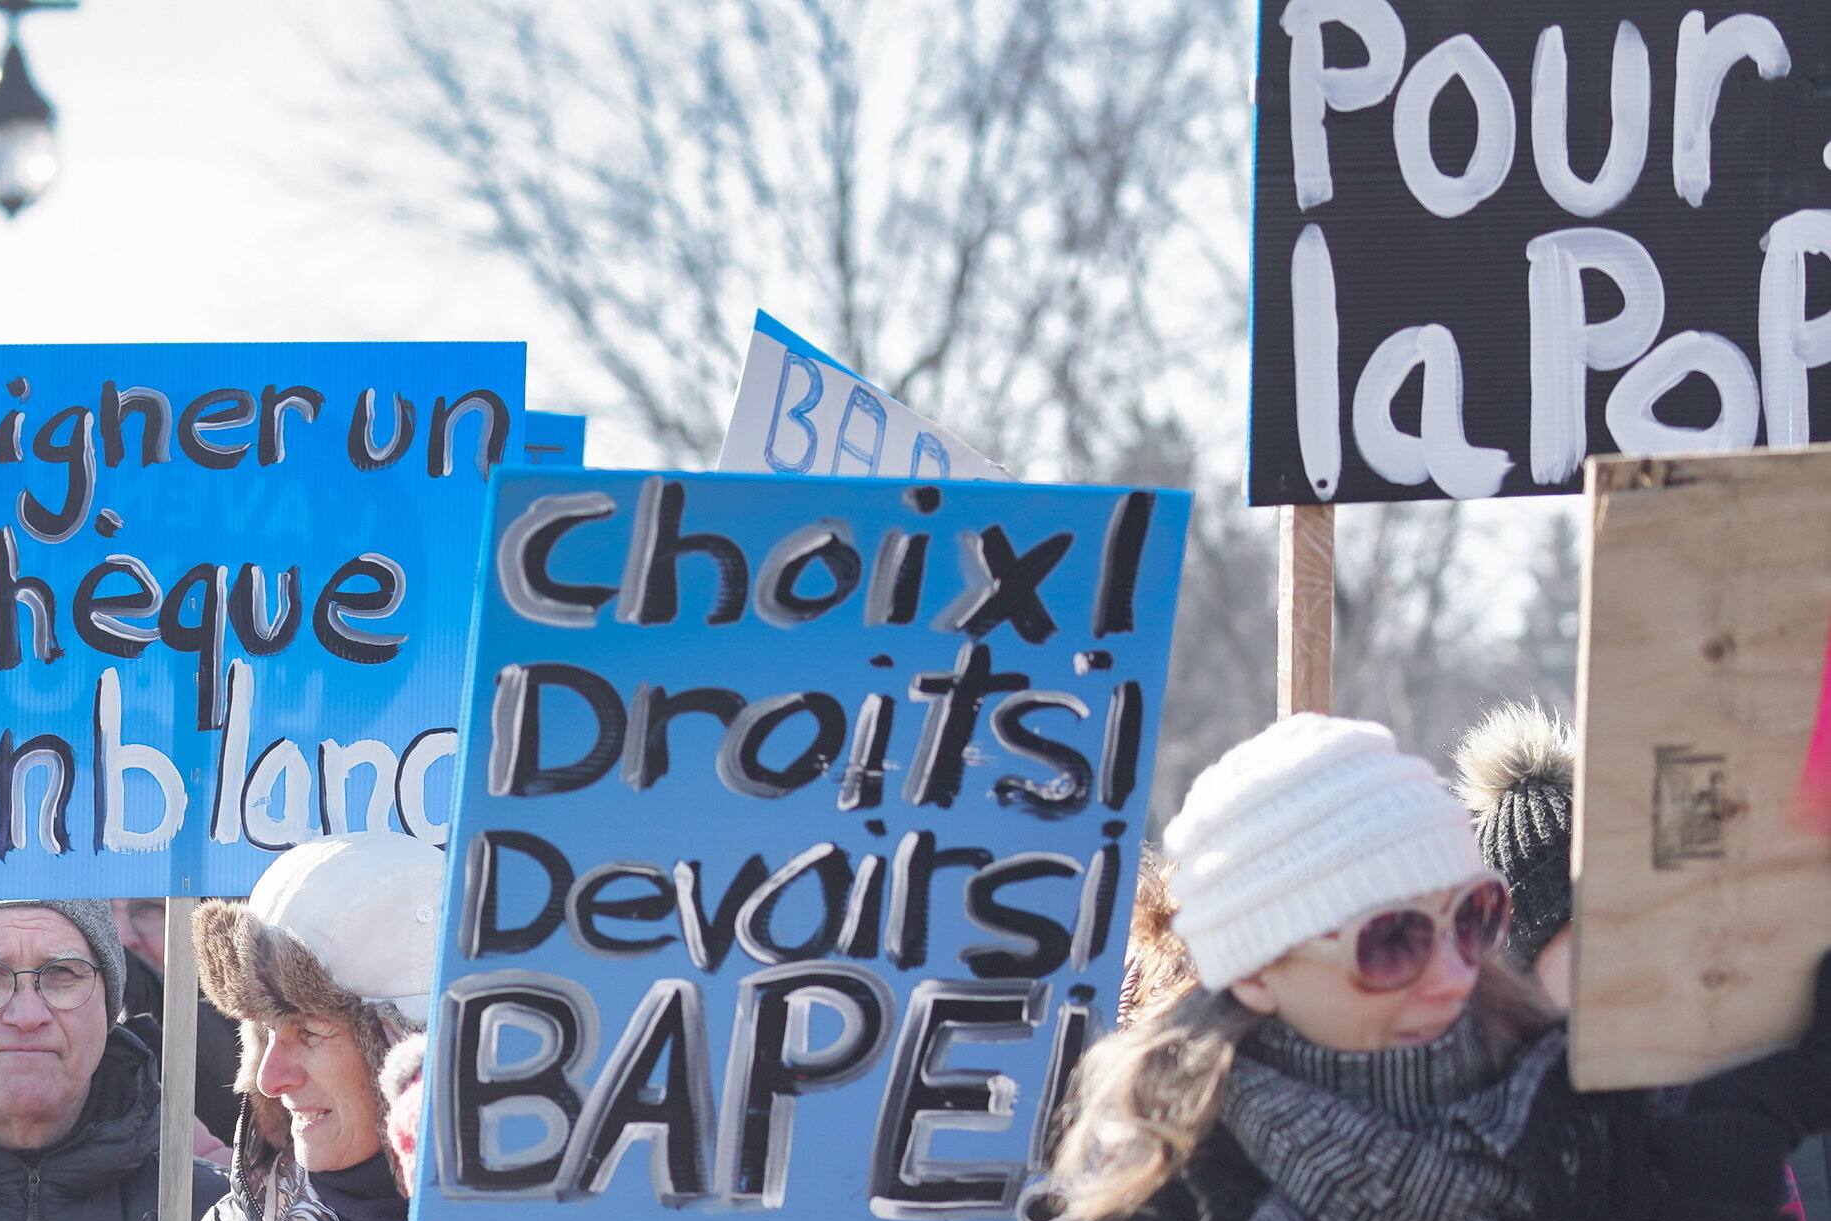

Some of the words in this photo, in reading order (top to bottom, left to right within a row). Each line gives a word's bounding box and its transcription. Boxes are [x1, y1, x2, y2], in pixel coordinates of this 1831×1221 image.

[1280, 0, 1791, 218] Pour
[348, 387, 510, 482] un
[765, 350, 991, 482] BA
[1291, 223, 1516, 501] la
